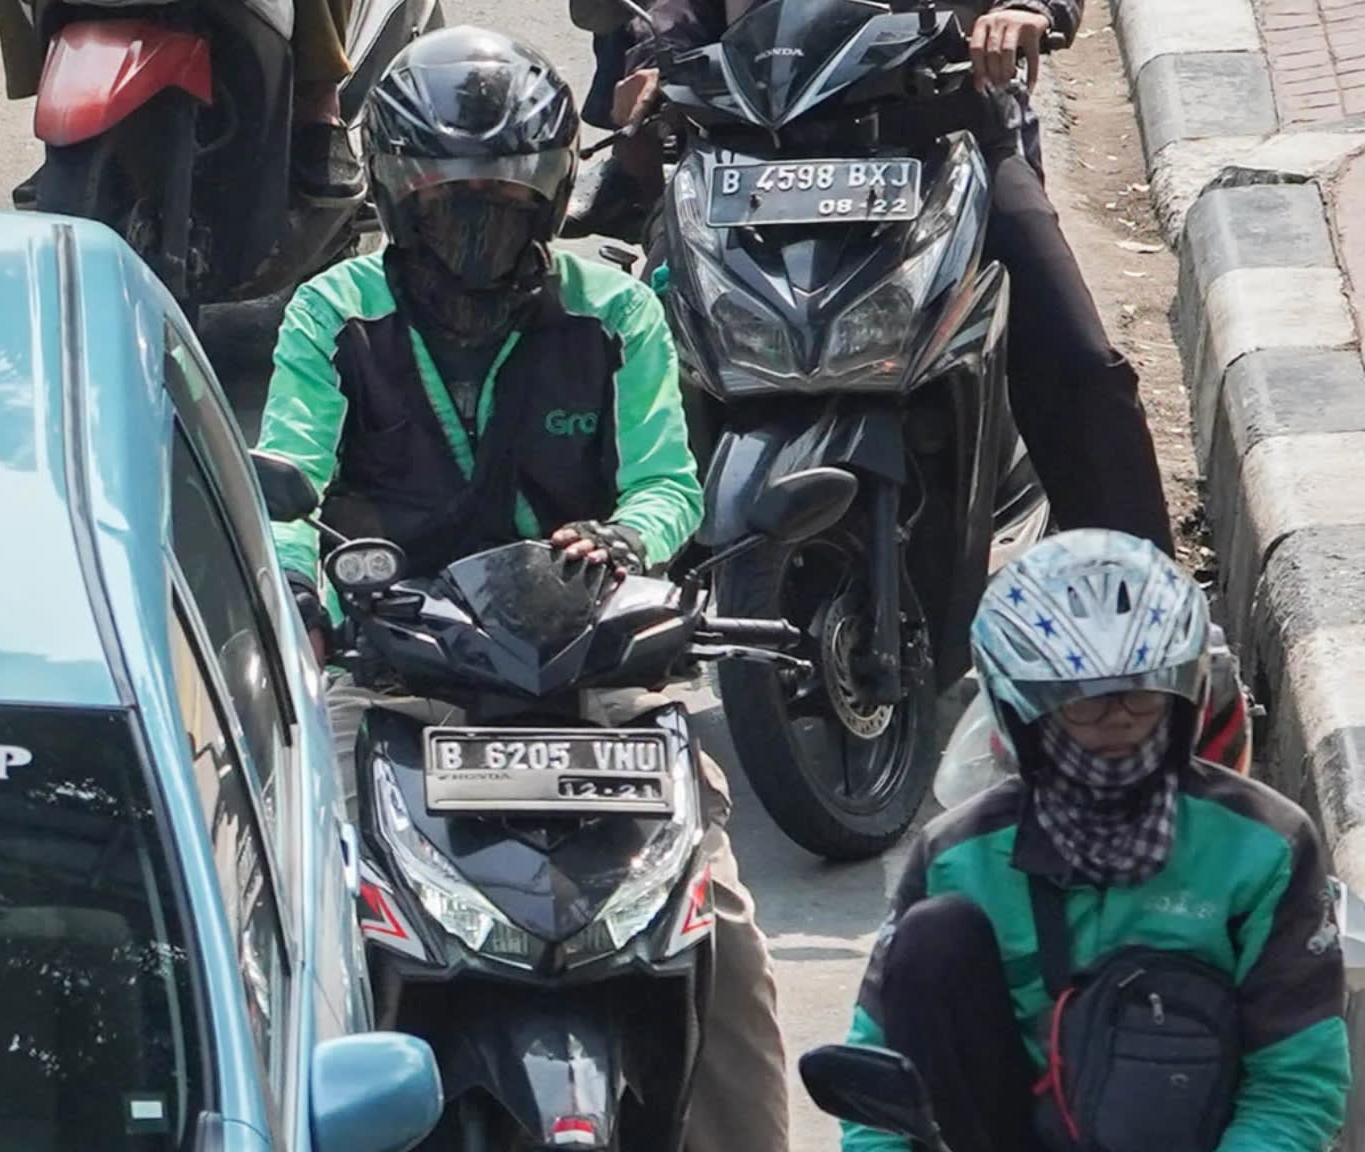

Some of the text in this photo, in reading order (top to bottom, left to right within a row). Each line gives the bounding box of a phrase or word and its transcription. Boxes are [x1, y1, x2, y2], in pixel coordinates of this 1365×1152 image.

[722, 163, 910, 195] B 4598 BXJ
[545, 408, 599, 436] Gra
[441, 741, 657, 771] B 6205 VNU
